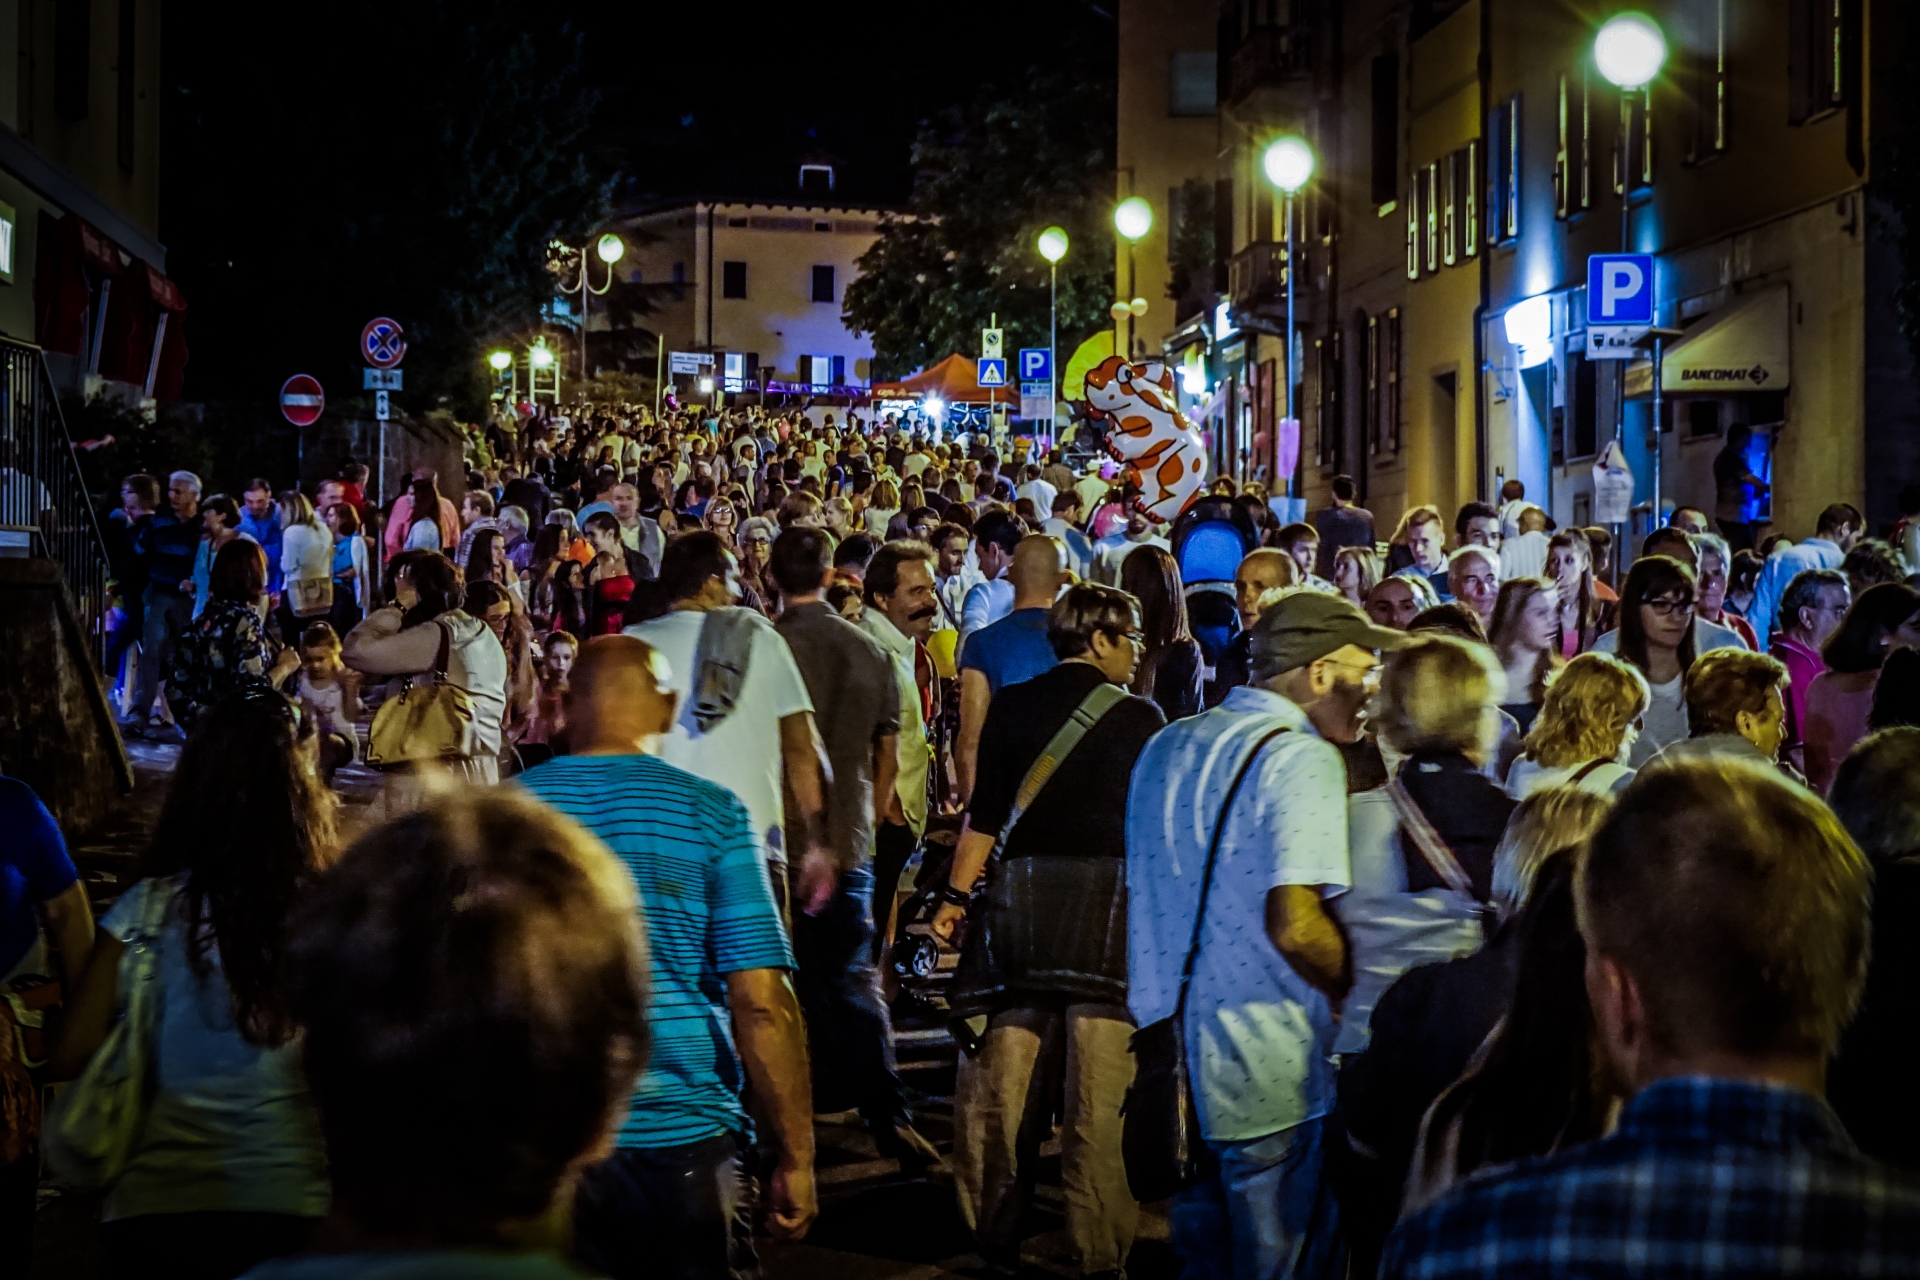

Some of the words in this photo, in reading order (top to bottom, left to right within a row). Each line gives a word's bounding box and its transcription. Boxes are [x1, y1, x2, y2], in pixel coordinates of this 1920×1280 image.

[1601, 261, 1643, 317] P
[1025, 352, 1045, 378] P
[1681, 369, 1747, 381] BANCOMAT
